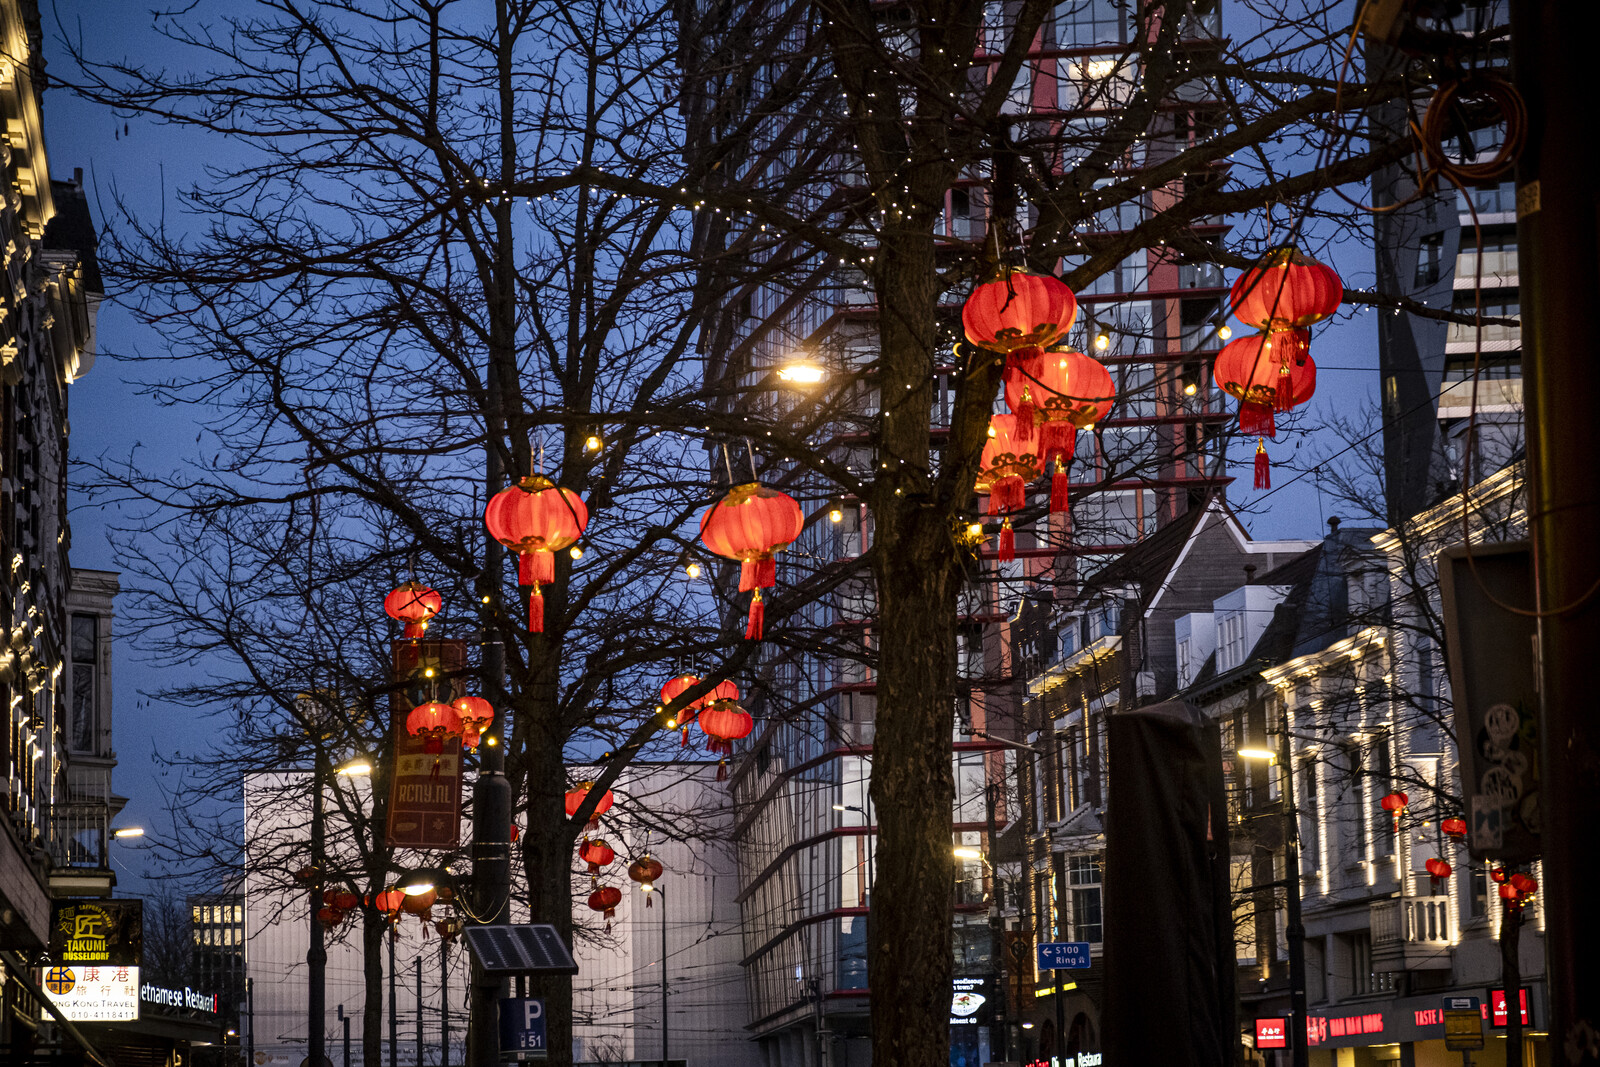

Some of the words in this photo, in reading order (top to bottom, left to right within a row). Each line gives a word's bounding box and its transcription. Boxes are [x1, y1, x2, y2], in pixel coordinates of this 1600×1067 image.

[73, 914, 105, 939] 匠
[1055, 956, 1076, 966] Ring
[140, 981, 183, 1007] etnamese
[52, 1000, 71, 1008] ONG
[72, 1000, 99, 1008] KONG
[101, 1000, 136, 1008] TRAVEL
[524, 1000, 542, 1029] P
[1414, 1009, 1437, 1026] TASTE
[528, 1035, 541, 1047] 51
